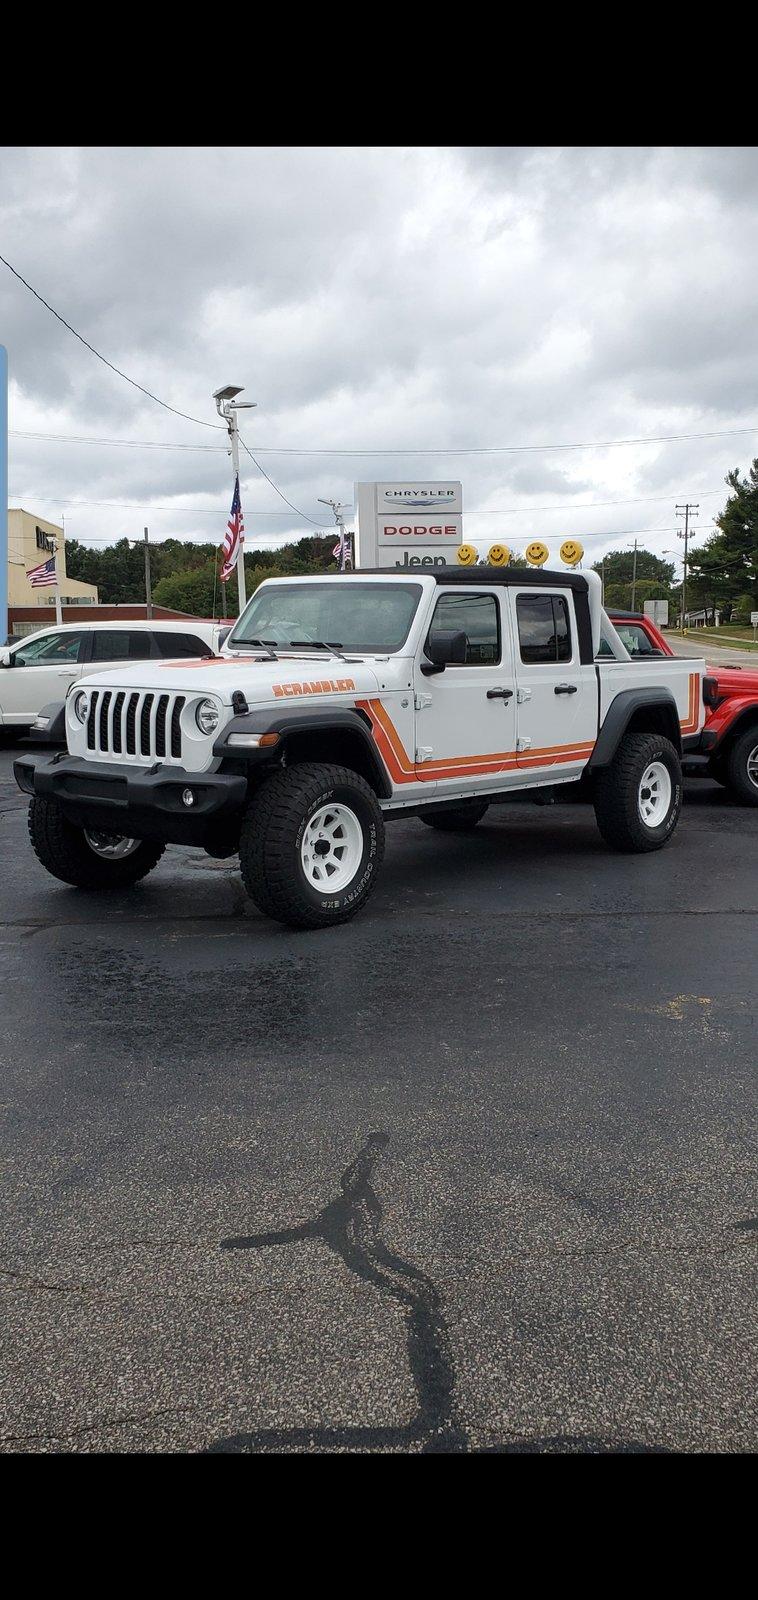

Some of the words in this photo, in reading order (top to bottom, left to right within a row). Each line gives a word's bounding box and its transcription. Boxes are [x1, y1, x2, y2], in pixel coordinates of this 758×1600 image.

[383, 525, 457, 535] DODGE
[271, 678, 356, 697] SCRAMBLER
[369, 823, 377, 858] TRAIL
[343, 862, 374, 906] COUNTRY
